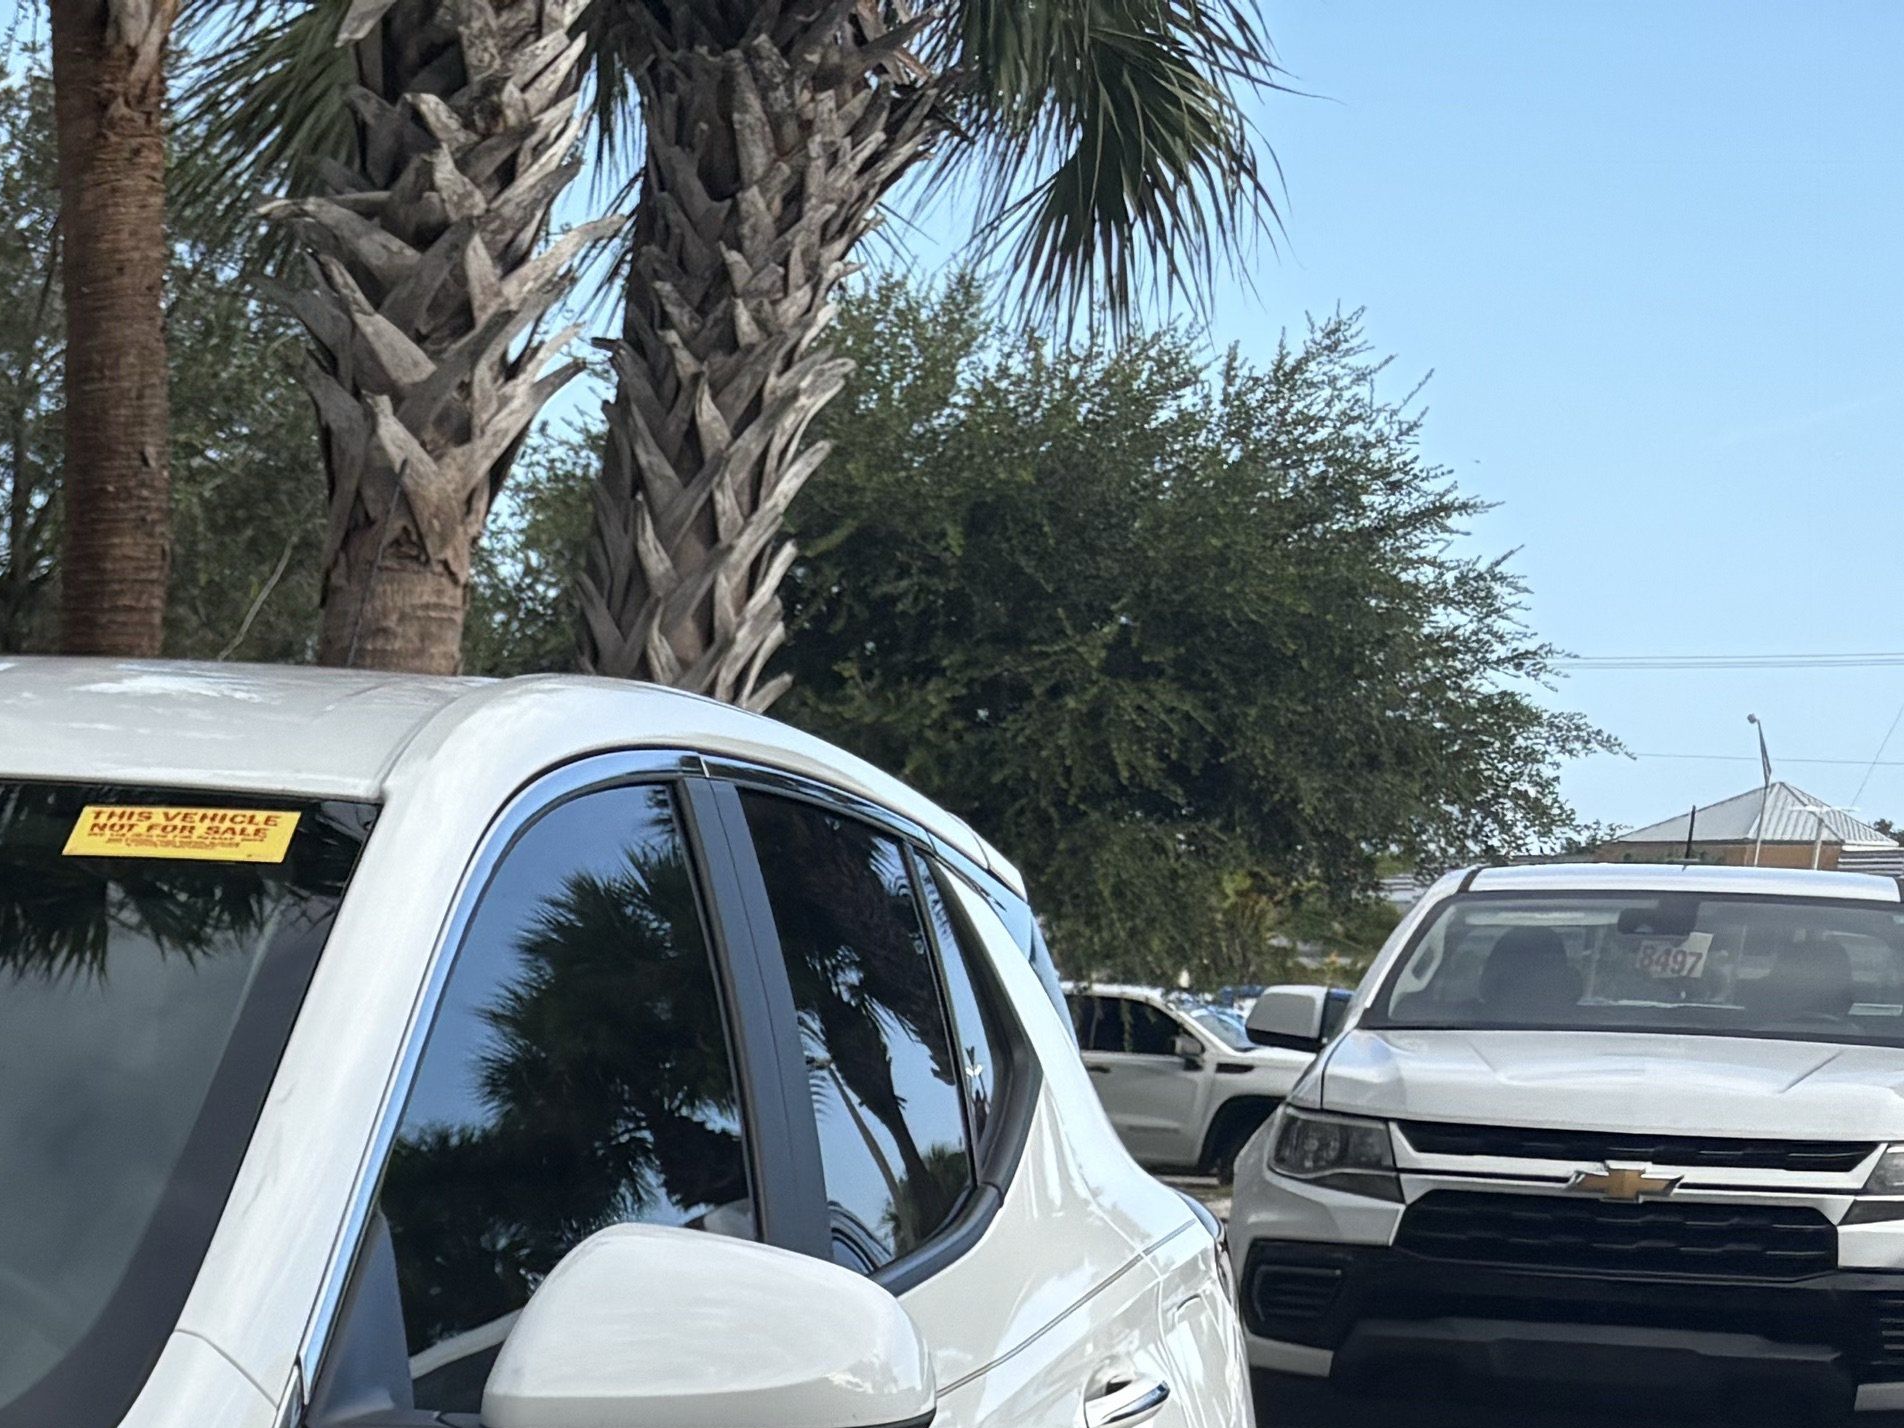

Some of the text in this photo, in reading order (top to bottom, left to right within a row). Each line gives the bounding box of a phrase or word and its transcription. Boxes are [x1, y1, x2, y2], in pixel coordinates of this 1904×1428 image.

[92, 810, 281, 827] THIS VEHICLE
[90, 822, 138, 833] NOT
[146, 823, 193, 835] FOR
[205, 825, 271, 838] SALE
